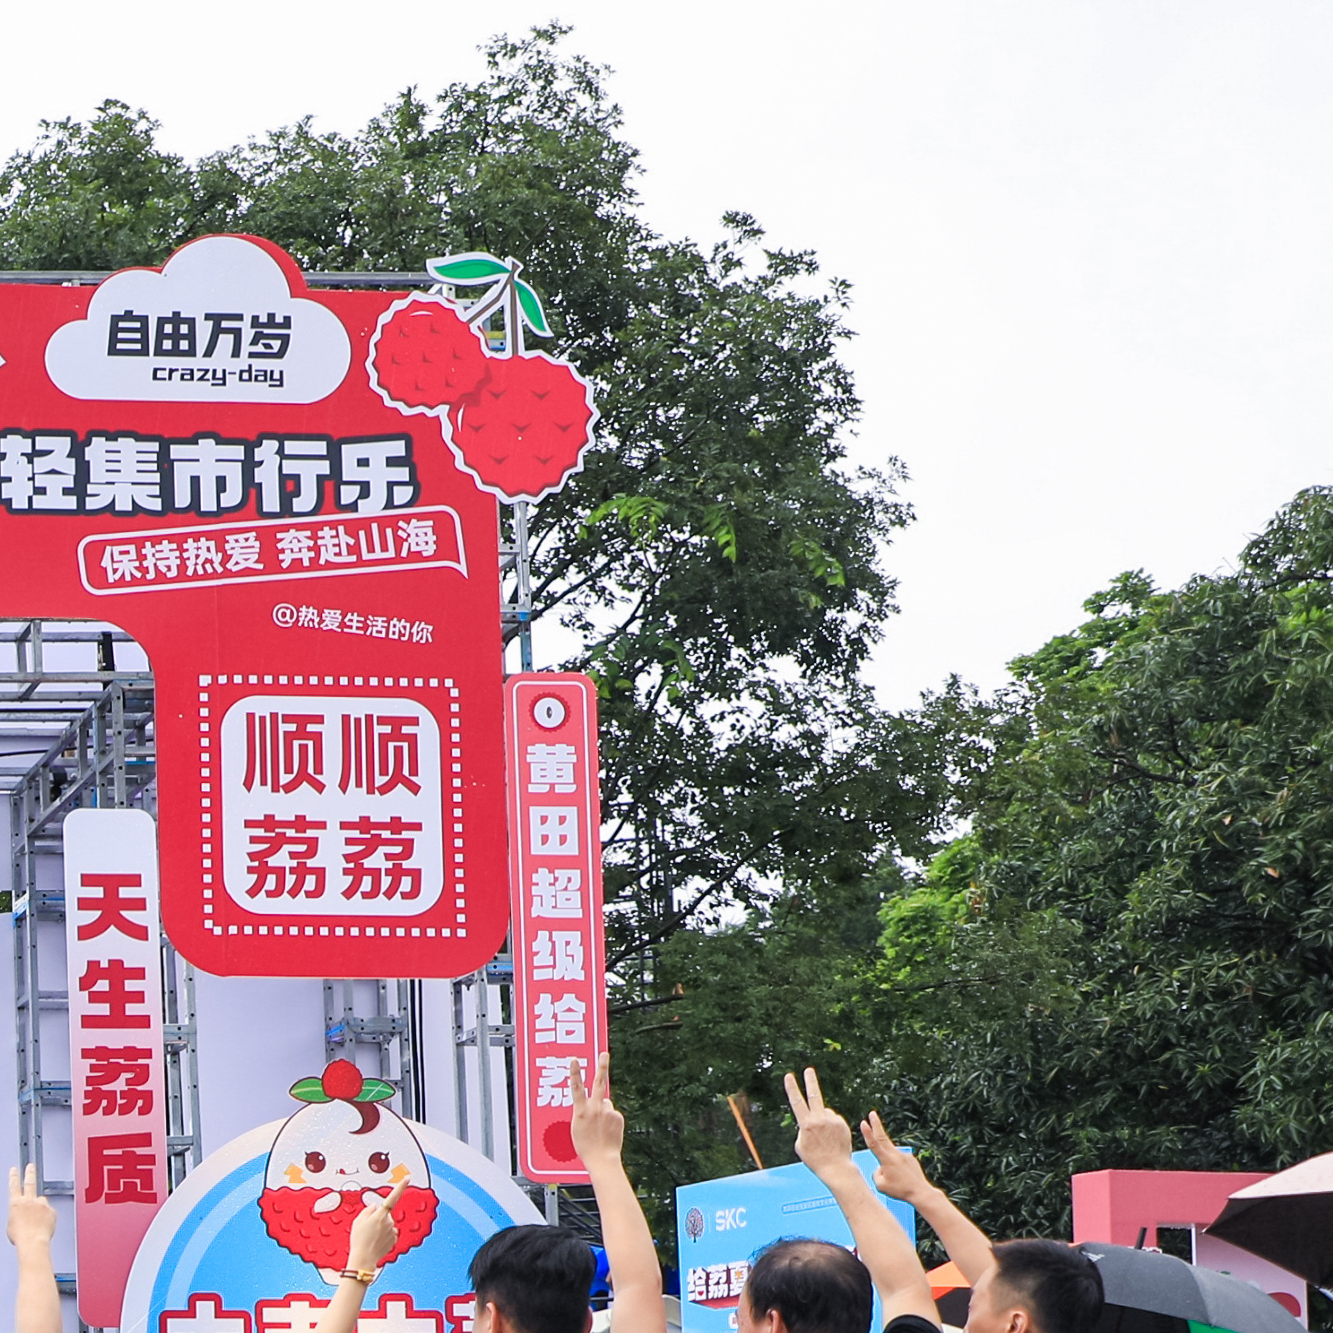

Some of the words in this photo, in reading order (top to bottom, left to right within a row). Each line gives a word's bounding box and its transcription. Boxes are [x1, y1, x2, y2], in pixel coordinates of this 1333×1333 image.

[106, 309, 293, 361] 自由万岁
[151, 362, 287, 389] crazy-day
[101, 529, 265, 583] 保持热爱
[276, 517, 438, 571] 奔赴山海
[271, 602, 434, 646] @热爱生活的你
[241, 711, 422, 796] 顺顺
[242, 813, 424, 901] 荔荔
[76, 872, 160, 1206] 天生荔质
[715, 1207, 747, 1232] SKC
